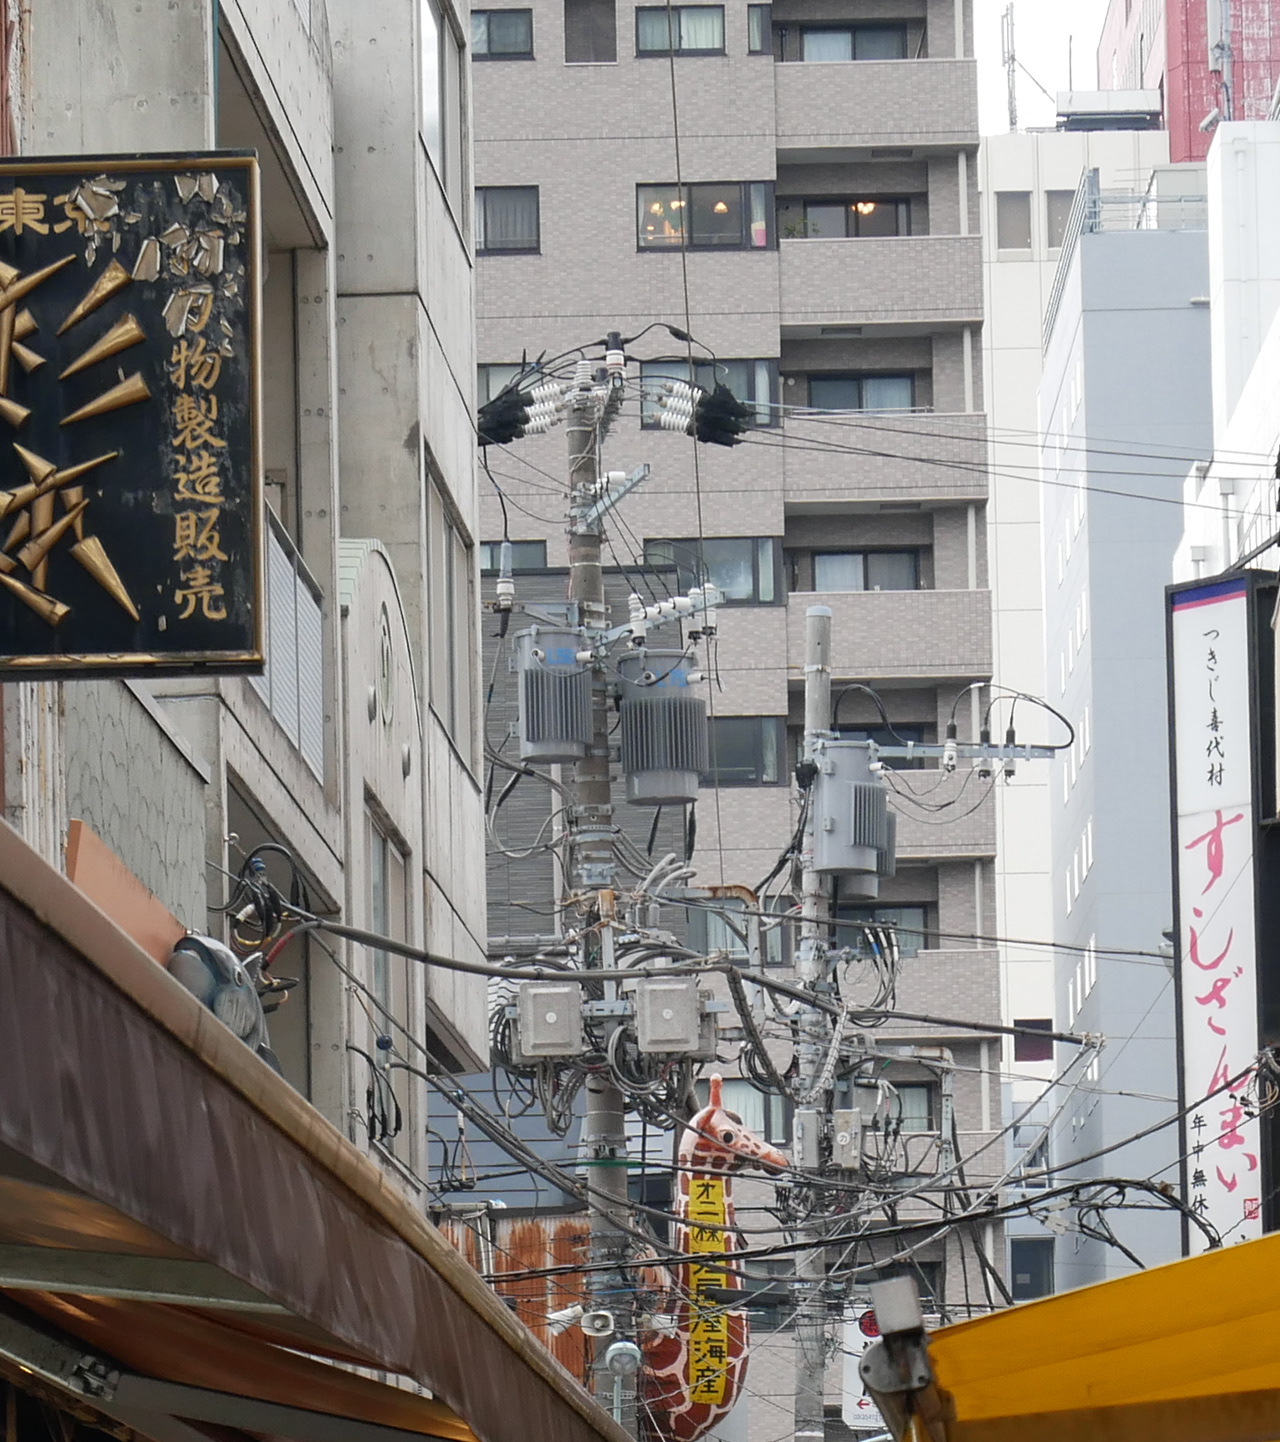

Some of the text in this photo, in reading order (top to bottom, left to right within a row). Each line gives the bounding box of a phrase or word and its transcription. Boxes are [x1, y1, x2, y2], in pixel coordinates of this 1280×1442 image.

[1202, 628, 1226, 787] つきじ喜代村
[1184, 808, 1259, 1193] すしざんまい
[1190, 1113, 1210, 1217] 年中無休
